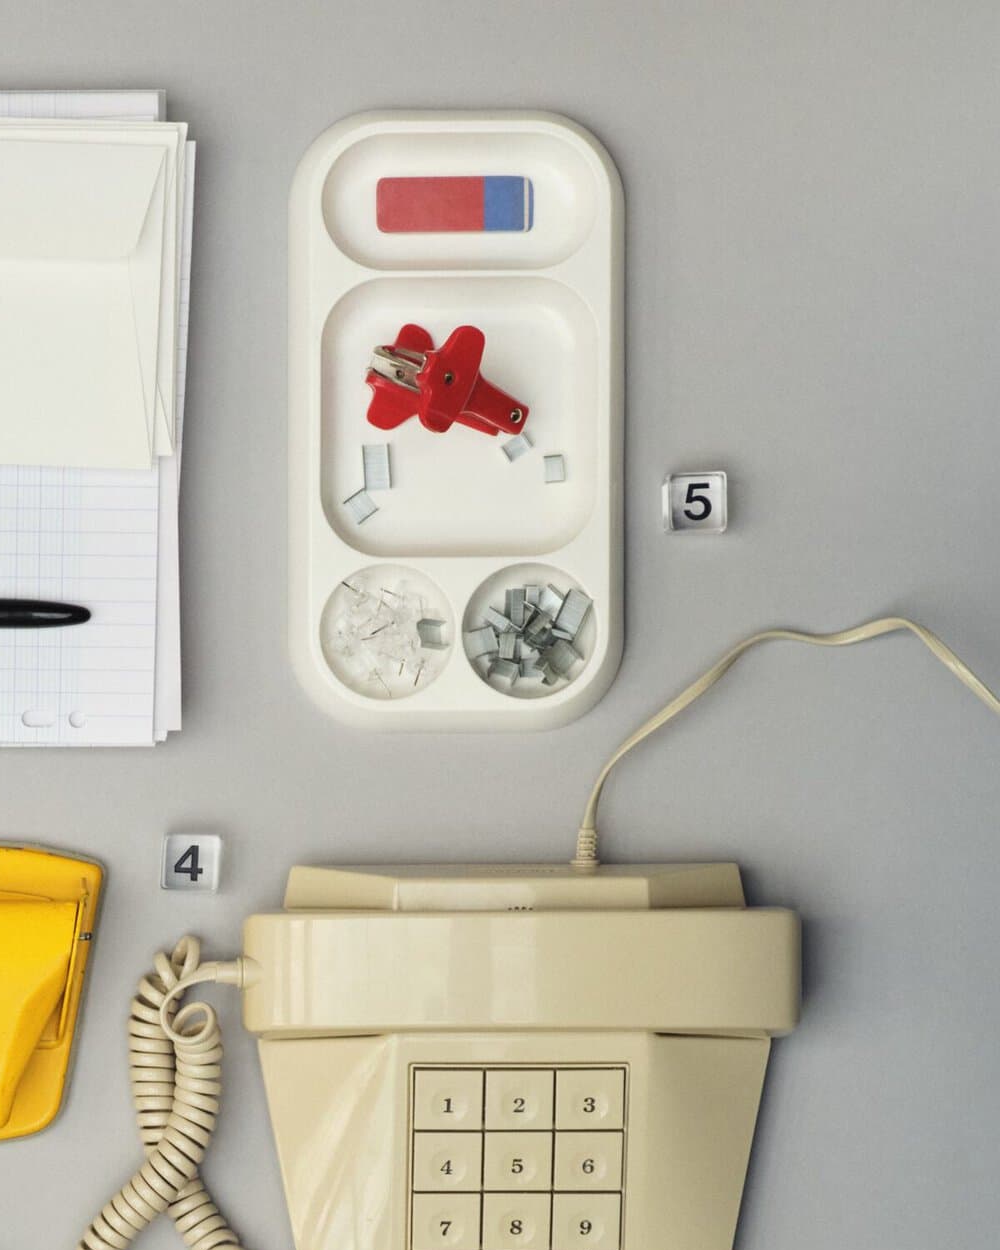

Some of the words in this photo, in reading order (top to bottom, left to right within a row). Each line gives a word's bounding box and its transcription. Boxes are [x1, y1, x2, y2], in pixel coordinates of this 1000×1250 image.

[684, 482, 712, 520] 5
[174, 845, 203, 881] 4
[443, 1098, 453, 1113] 1
[513, 1098, 525, 1113] 2
[583, 1097, 595, 1113] 3
[440, 1160, 453, 1175] 4
[511, 1159, 523, 1174] 5
[582, 1159, 594, 1174] 6
[440, 1221, 452, 1236] 7
[510, 1220, 523, 1235] 8
[580, 1220, 593, 1236] 9
